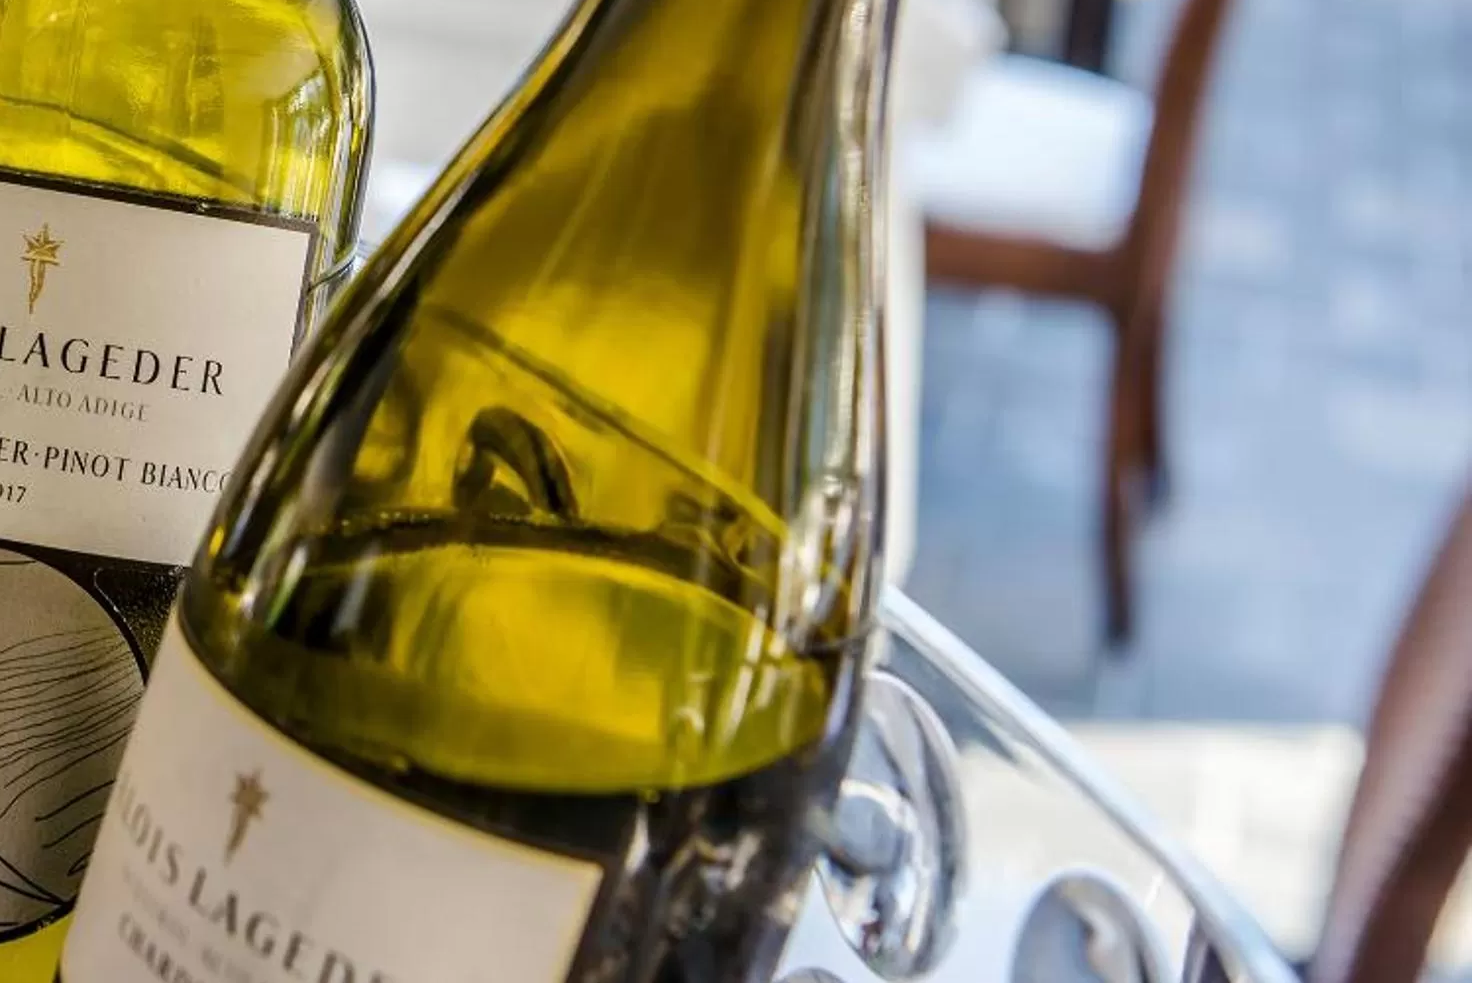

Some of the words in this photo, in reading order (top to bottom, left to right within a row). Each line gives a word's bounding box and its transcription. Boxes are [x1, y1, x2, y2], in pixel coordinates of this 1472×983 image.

[16, 383, 73, 410] ALTO
[78, 394, 150, 423] ADIGE
[188, 864, 399, 983] LAGED
